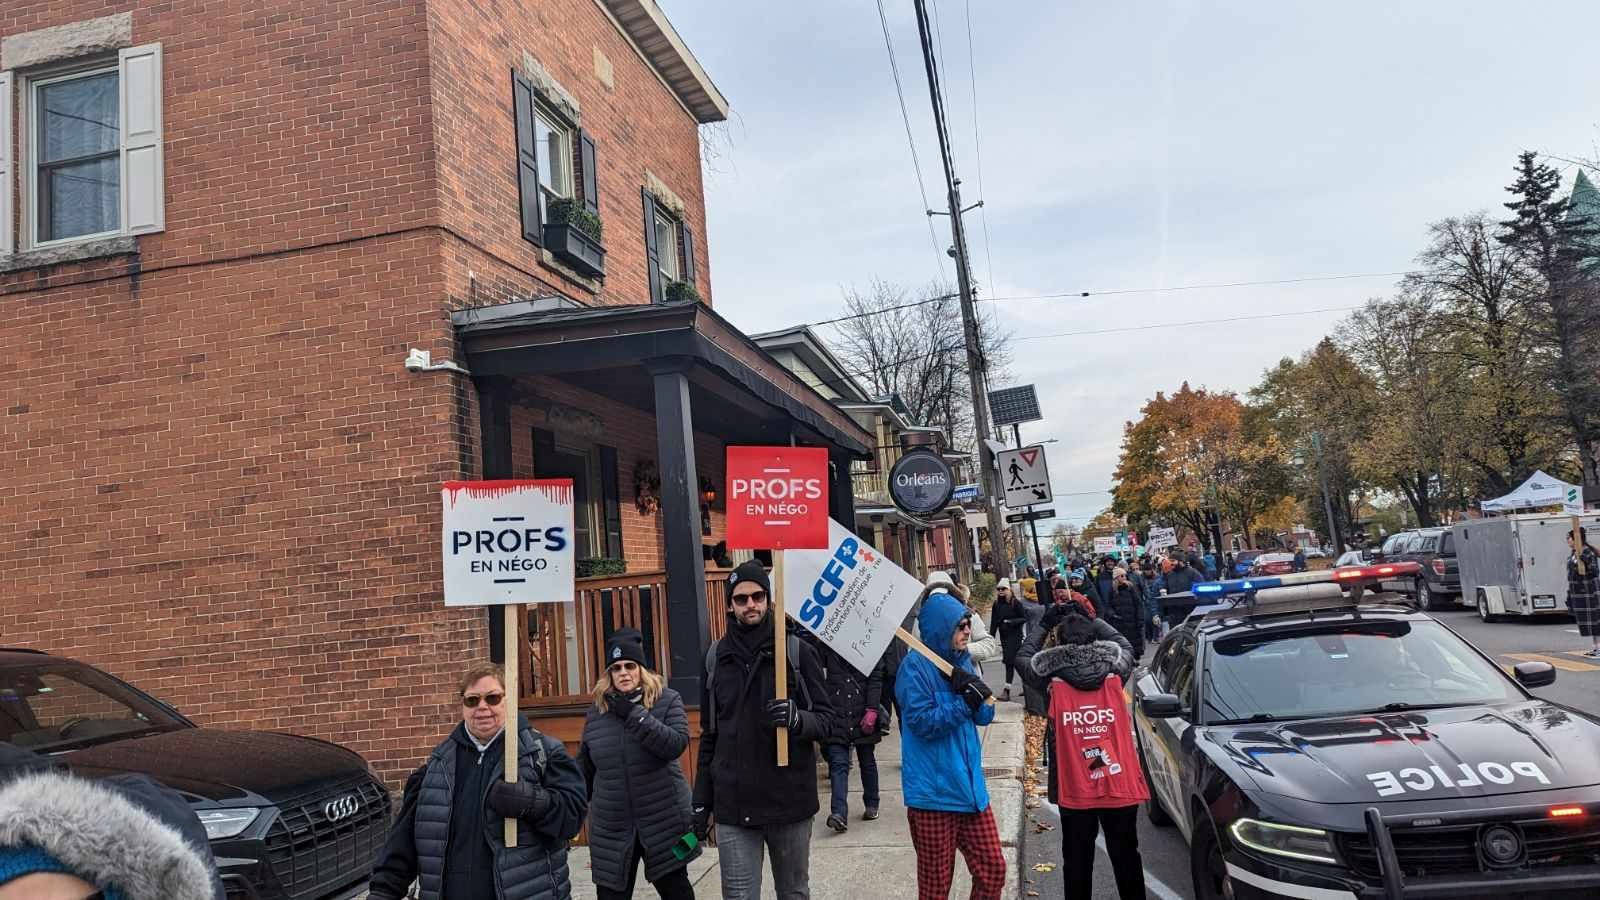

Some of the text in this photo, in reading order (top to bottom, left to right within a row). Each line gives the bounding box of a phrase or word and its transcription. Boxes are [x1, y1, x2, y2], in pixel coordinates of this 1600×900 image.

[732, 478, 821, 499] PROFS
[746, 501, 808, 515] EN NÉGO
[452, 526, 567, 555] PROFS
[471, 555, 548, 573] EN NÉGO
[799, 537, 859, 630] SCFP
[839, 576, 862, 611] canadien
[858, 565, 869, 578] de
[830, 604, 853, 636] fonction
[850, 572, 874, 609] publique
[1062, 708, 1115, 726] PROFS
[1073, 727, 1084, 735] EN
